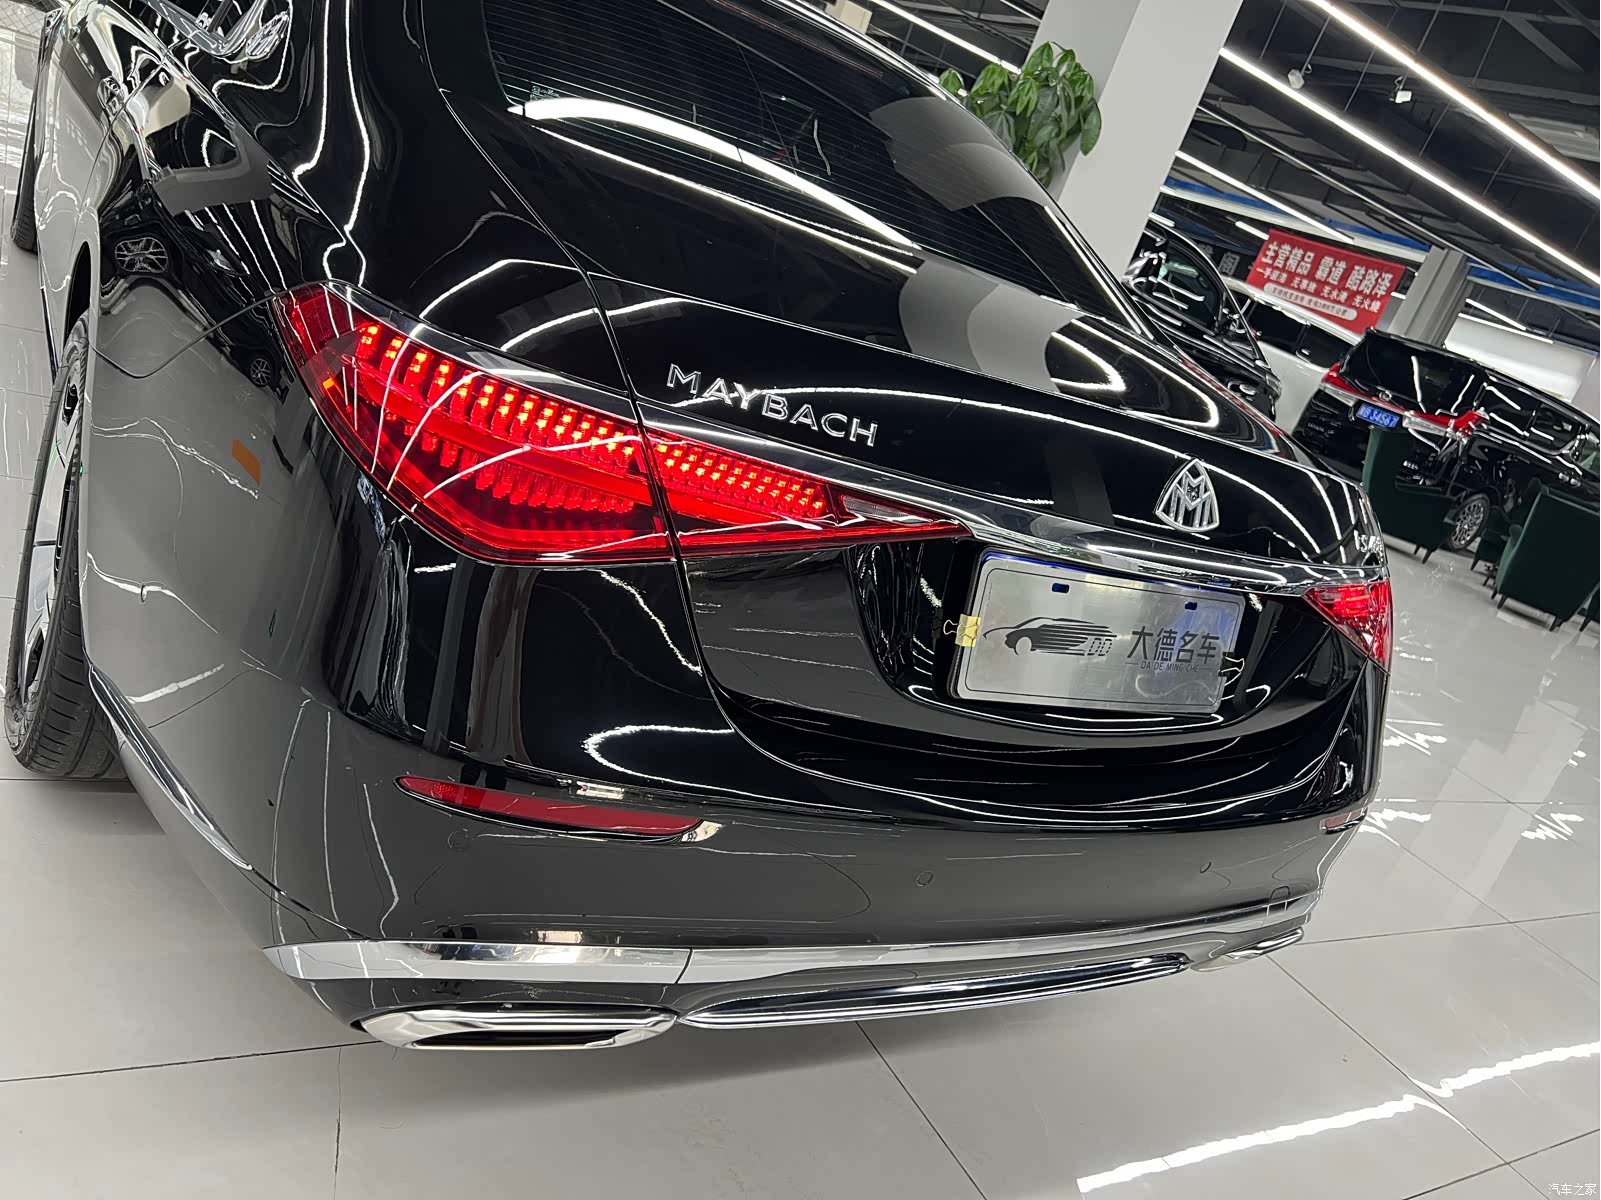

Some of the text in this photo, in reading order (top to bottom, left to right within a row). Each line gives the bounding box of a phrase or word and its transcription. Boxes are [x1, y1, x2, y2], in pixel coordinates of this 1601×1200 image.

[1262, 241, 1315, 275] 主营精品
[1315, 255, 1346, 284] 霸道
[1345, 265, 1393, 298] 酷路泽
[666, 363, 878, 447] MAYBACH
[1127, 625, 1220, 664] 大德名车
[1140, 660, 1199, 673] DA DE MING CHE
